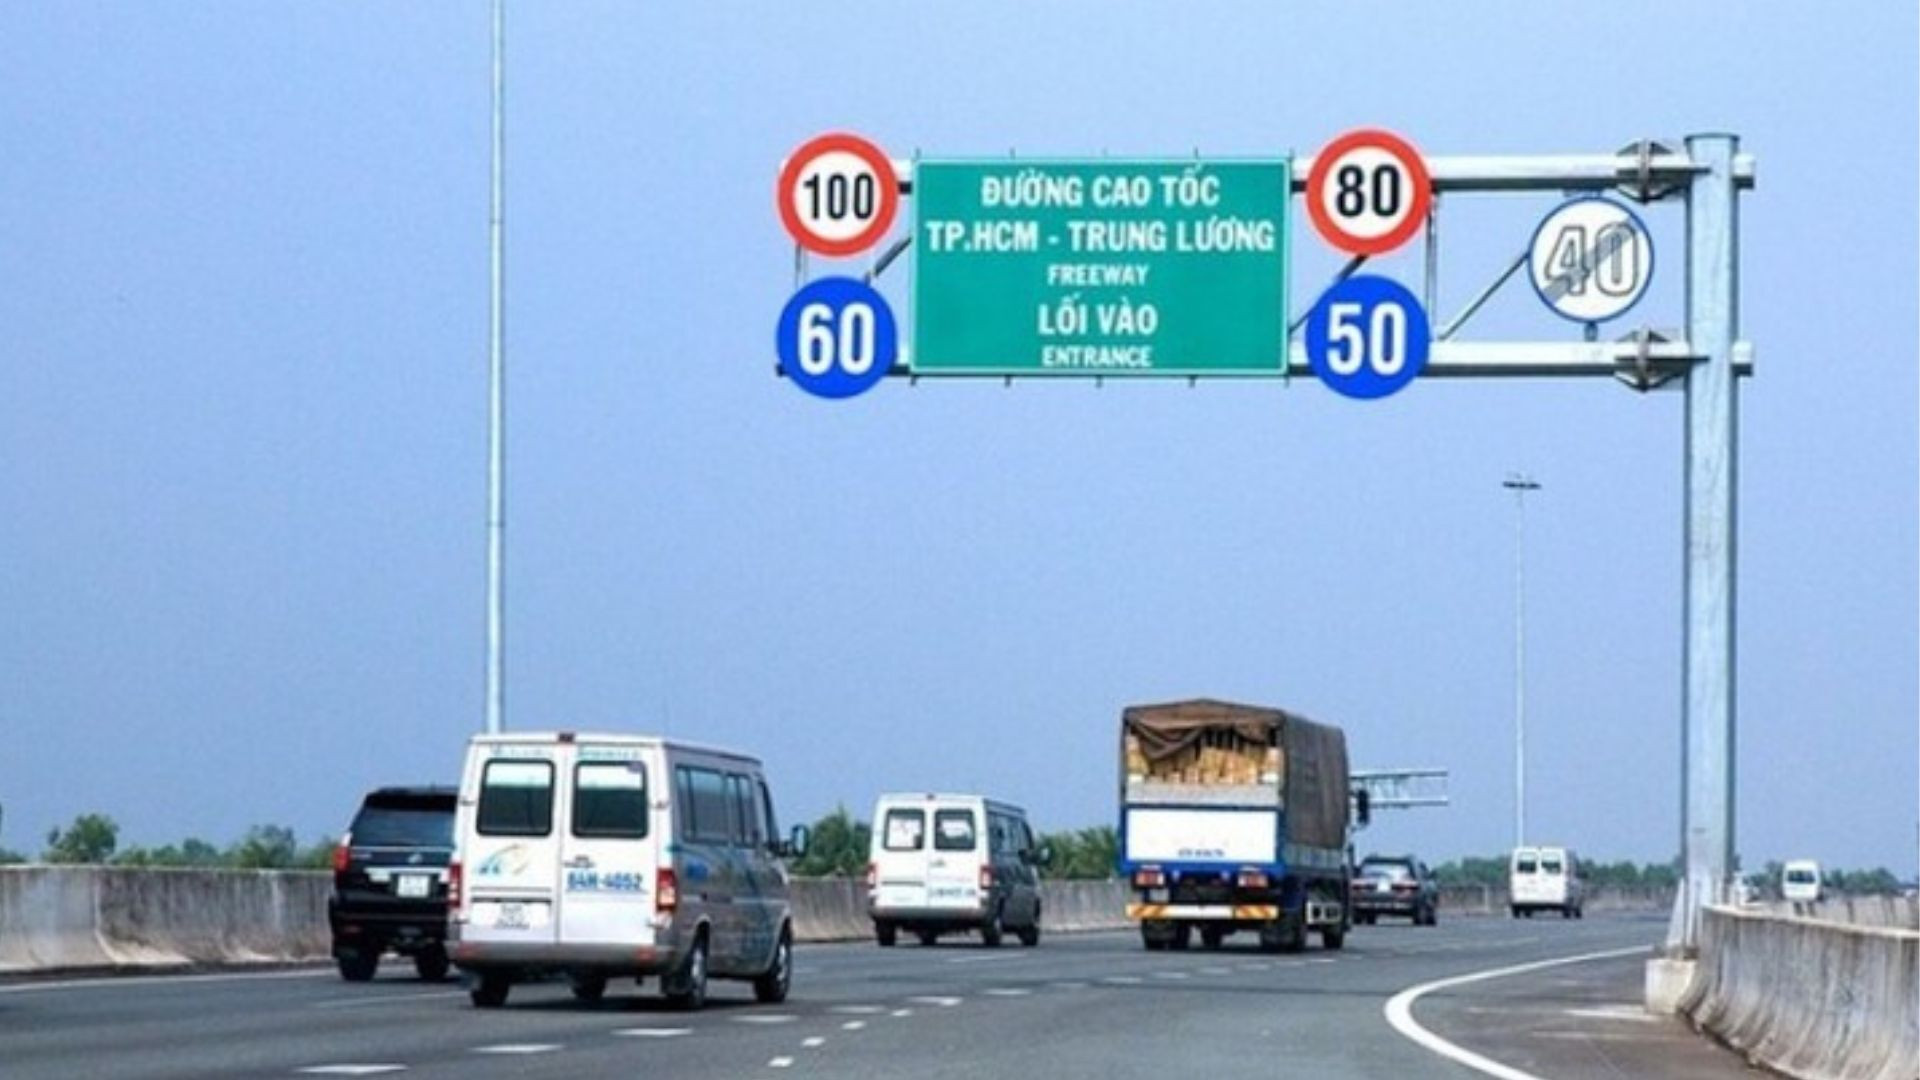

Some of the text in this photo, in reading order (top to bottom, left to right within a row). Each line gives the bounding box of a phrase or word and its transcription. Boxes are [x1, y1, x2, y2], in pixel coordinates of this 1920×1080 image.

[803, 172, 876, 221] 100
[980, 163, 1221, 208] ĐƯỜNG CAO TỐC
[1335, 164, 1401, 217] 80
[926, 220, 1038, 252] TP.HCM
[1067, 220, 1167, 252] TRUNG
[1176, 215, 1275, 252] LƯƠNG
[1047, 263, 1149, 286] FREEWAY
[1544, 222, 1639, 297] 40
[1038, 291, 1159, 335] LỐI VÀO
[797, 304, 876, 375] 60
[1042, 345, 1152, 368] ENTRANCE
[1327, 302, 1407, 376] 50
